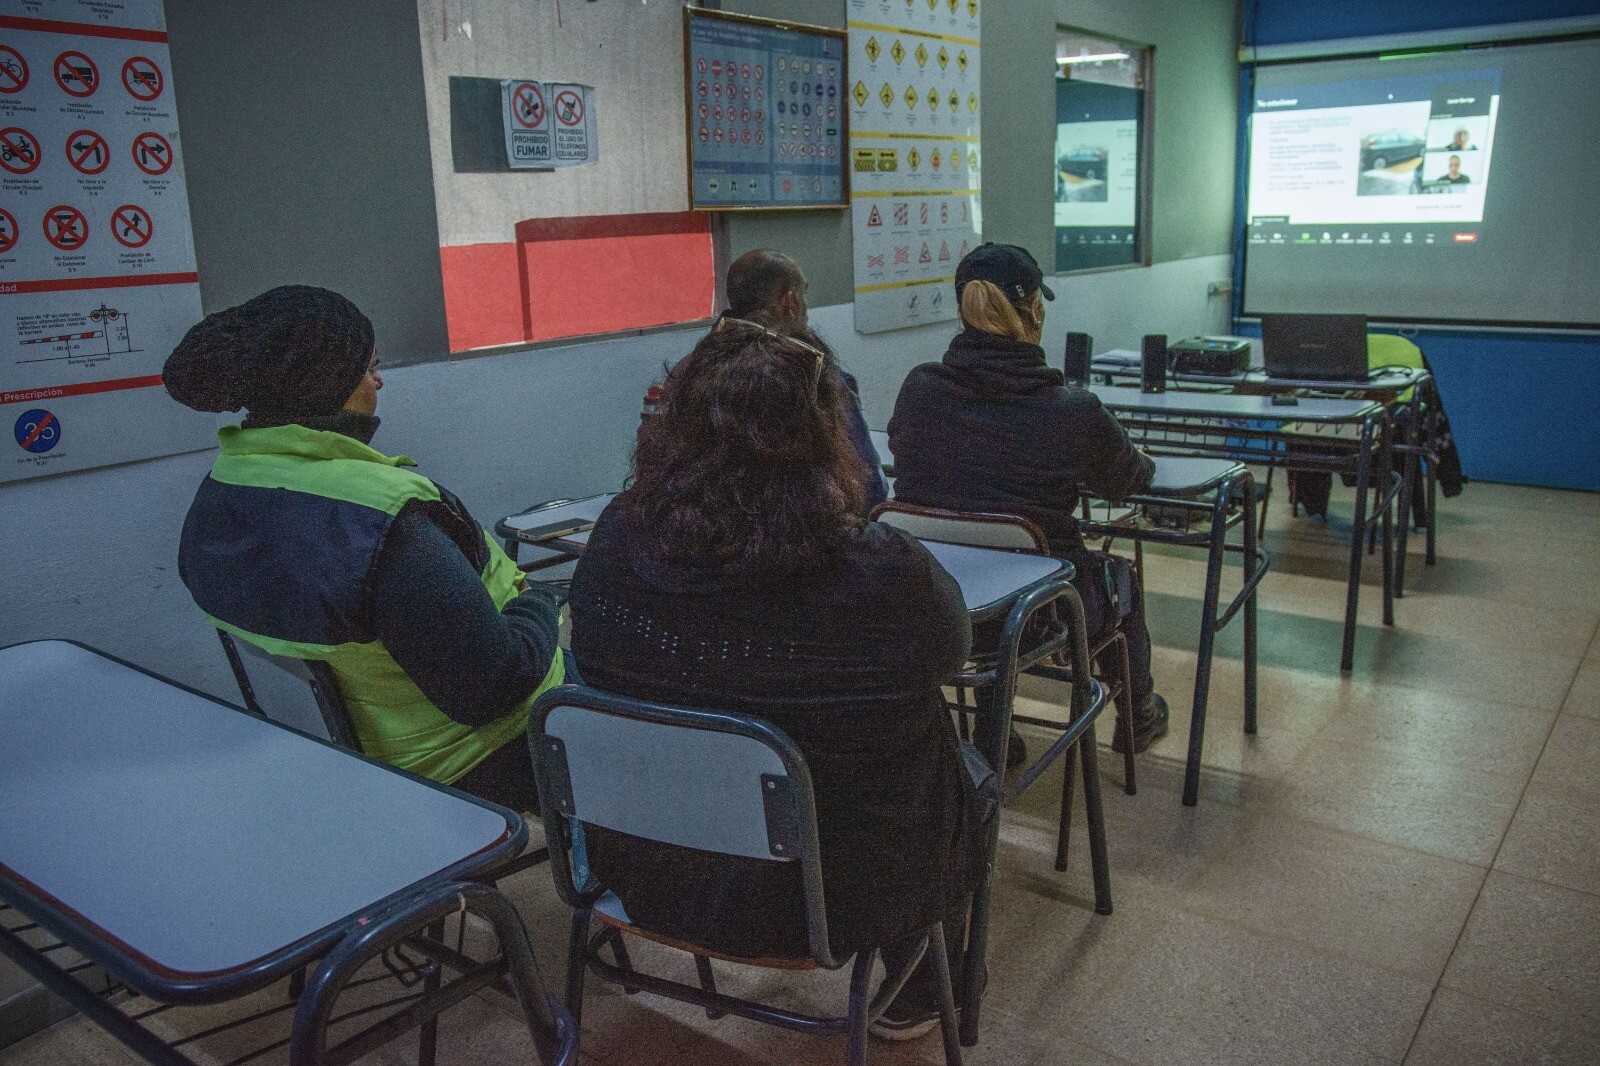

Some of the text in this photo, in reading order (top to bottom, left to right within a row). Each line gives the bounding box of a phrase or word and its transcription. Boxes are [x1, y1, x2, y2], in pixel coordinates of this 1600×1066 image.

[514, 135, 548, 144] PROHIBIDO
[516, 145, 547, 156] FUMAR
[4, 388, 63, 402] Prescripción
